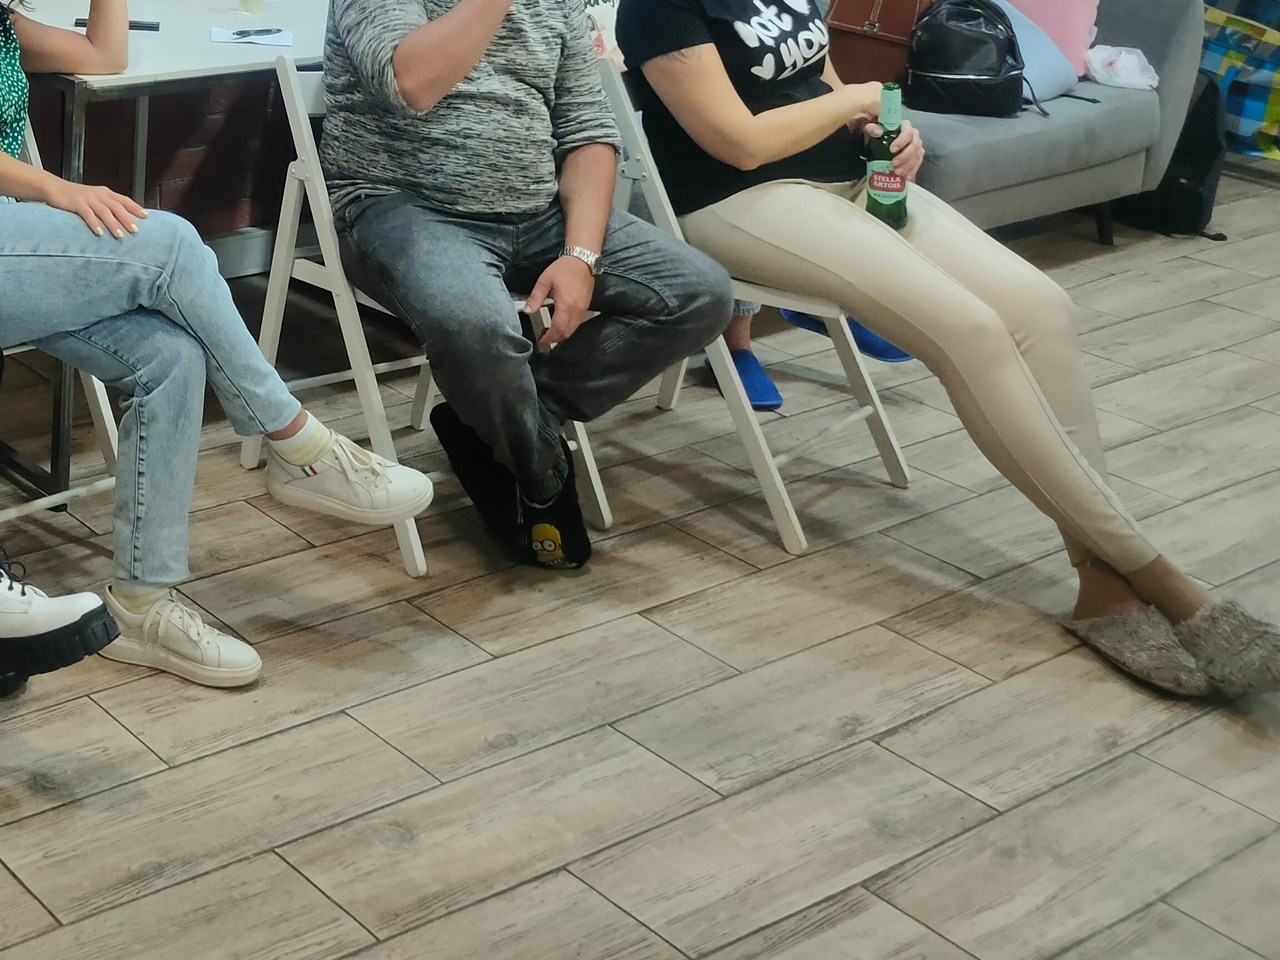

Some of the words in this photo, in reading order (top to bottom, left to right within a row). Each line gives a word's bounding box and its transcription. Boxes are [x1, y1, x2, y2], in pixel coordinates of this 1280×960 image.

[777, 18, 830, 80] you
[873, 174, 901, 183] STELLA
[873, 180, 901, 189] ARTOIS
